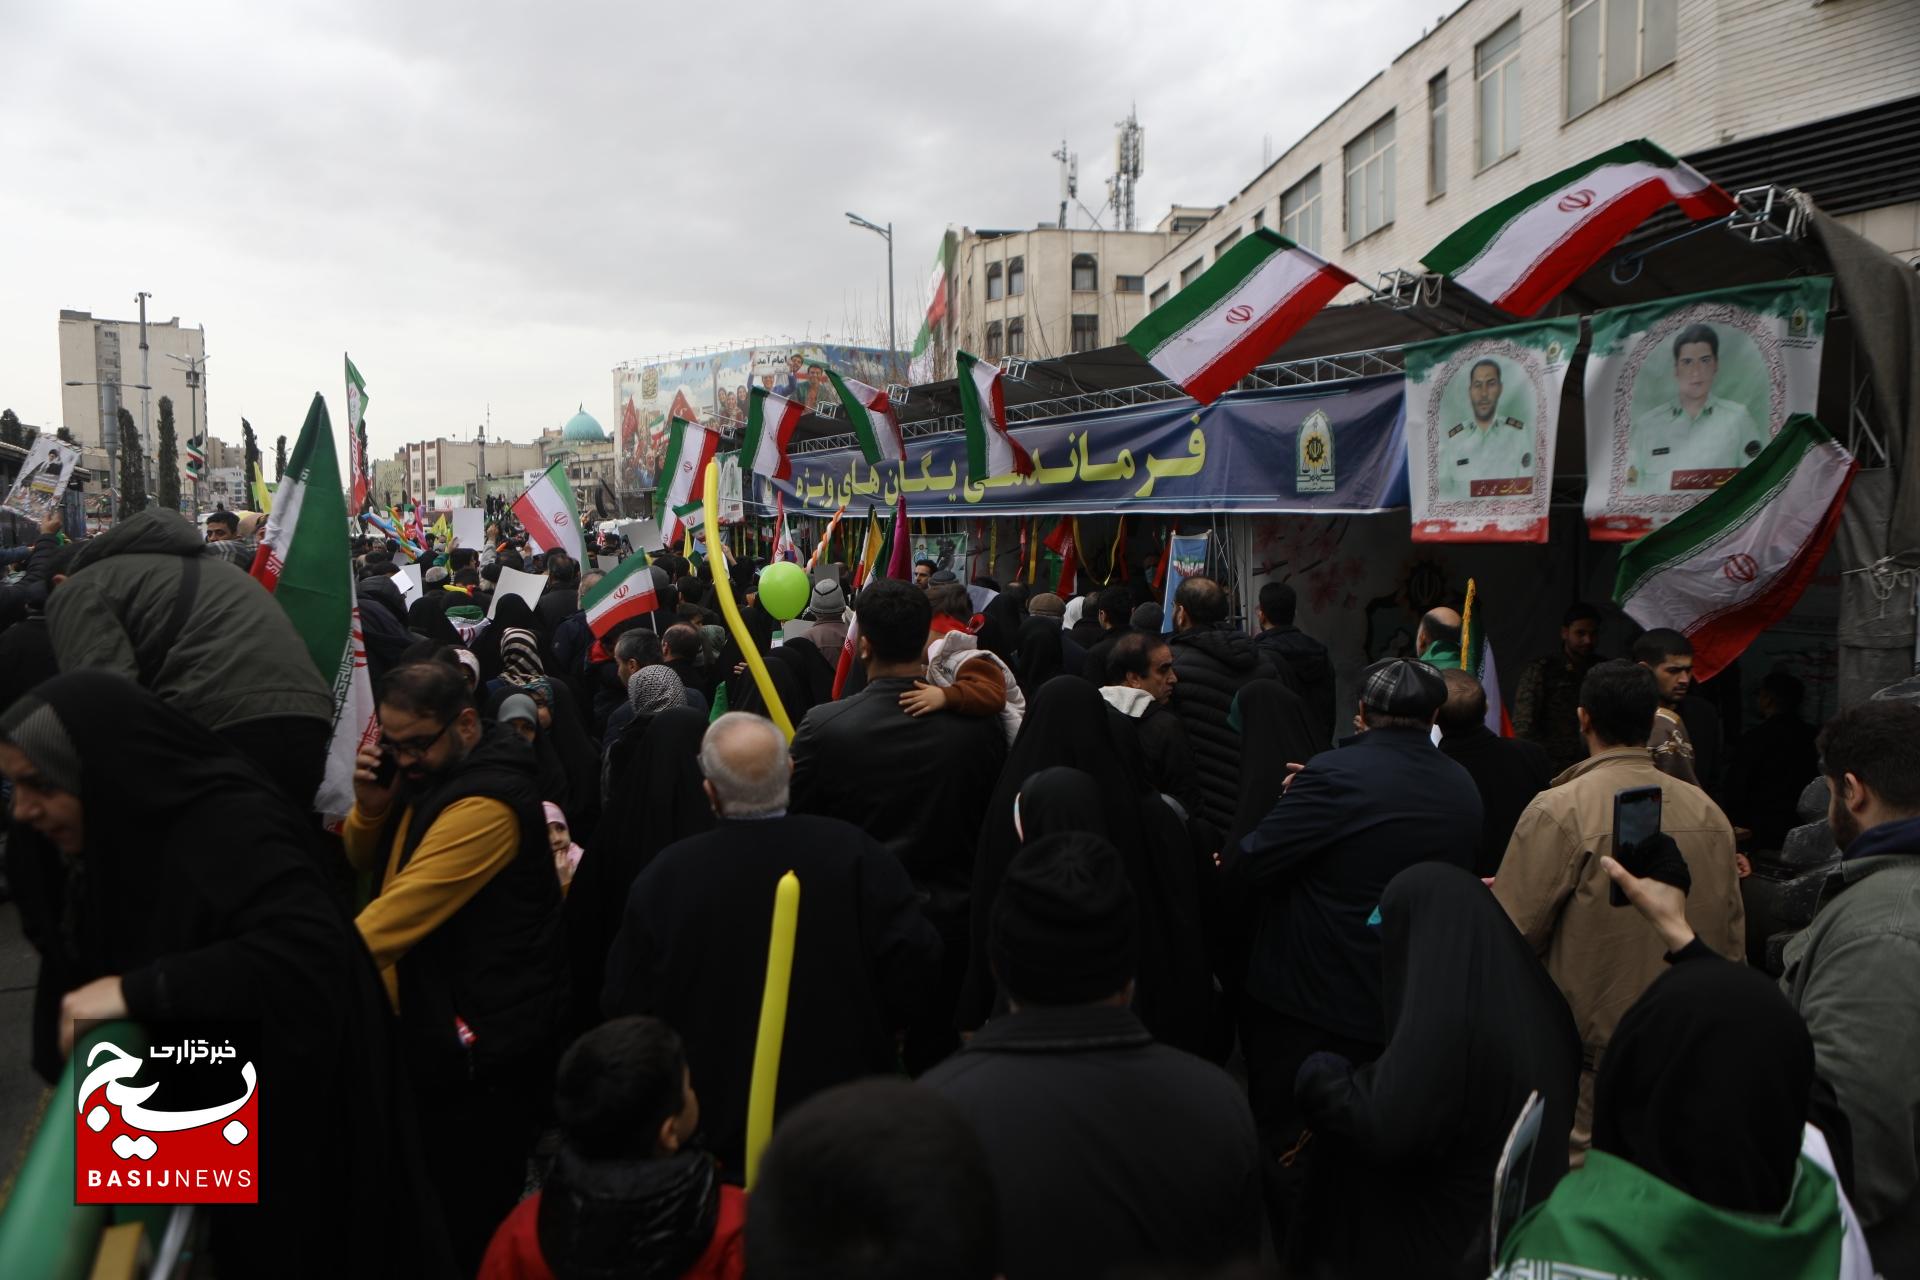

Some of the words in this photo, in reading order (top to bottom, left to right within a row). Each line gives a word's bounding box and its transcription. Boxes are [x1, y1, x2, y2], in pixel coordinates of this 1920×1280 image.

[757, 355, 770, 365] آمد
[771, 355, 787, 366] امام
[795, 467, 833, 508] ویژه
[837, 459, 880, 507] های
[884, 449, 958, 506] یگان
